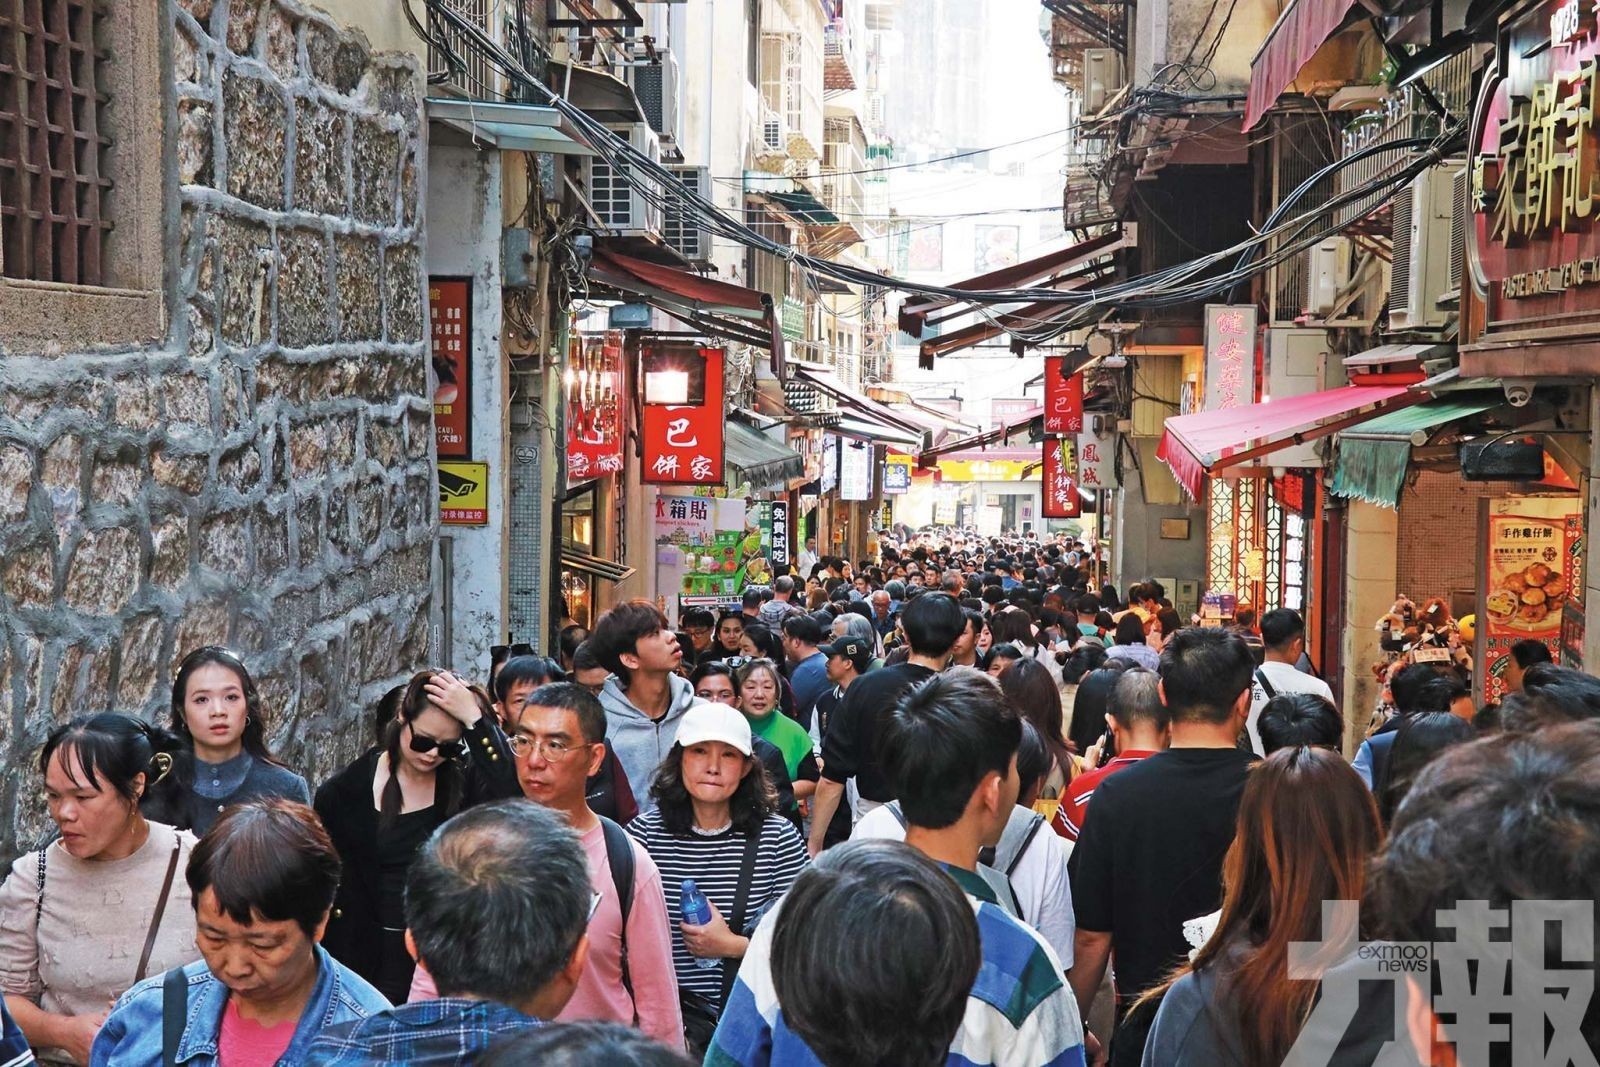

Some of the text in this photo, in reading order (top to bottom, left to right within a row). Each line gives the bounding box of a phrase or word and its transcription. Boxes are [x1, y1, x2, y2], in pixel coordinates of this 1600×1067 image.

[1054, 367, 1072, 413] 三巴
[664, 405, 698, 447] 巴
[1082, 443, 1101, 485] 鳳城
[772, 507, 786, 563] 免費試吃
